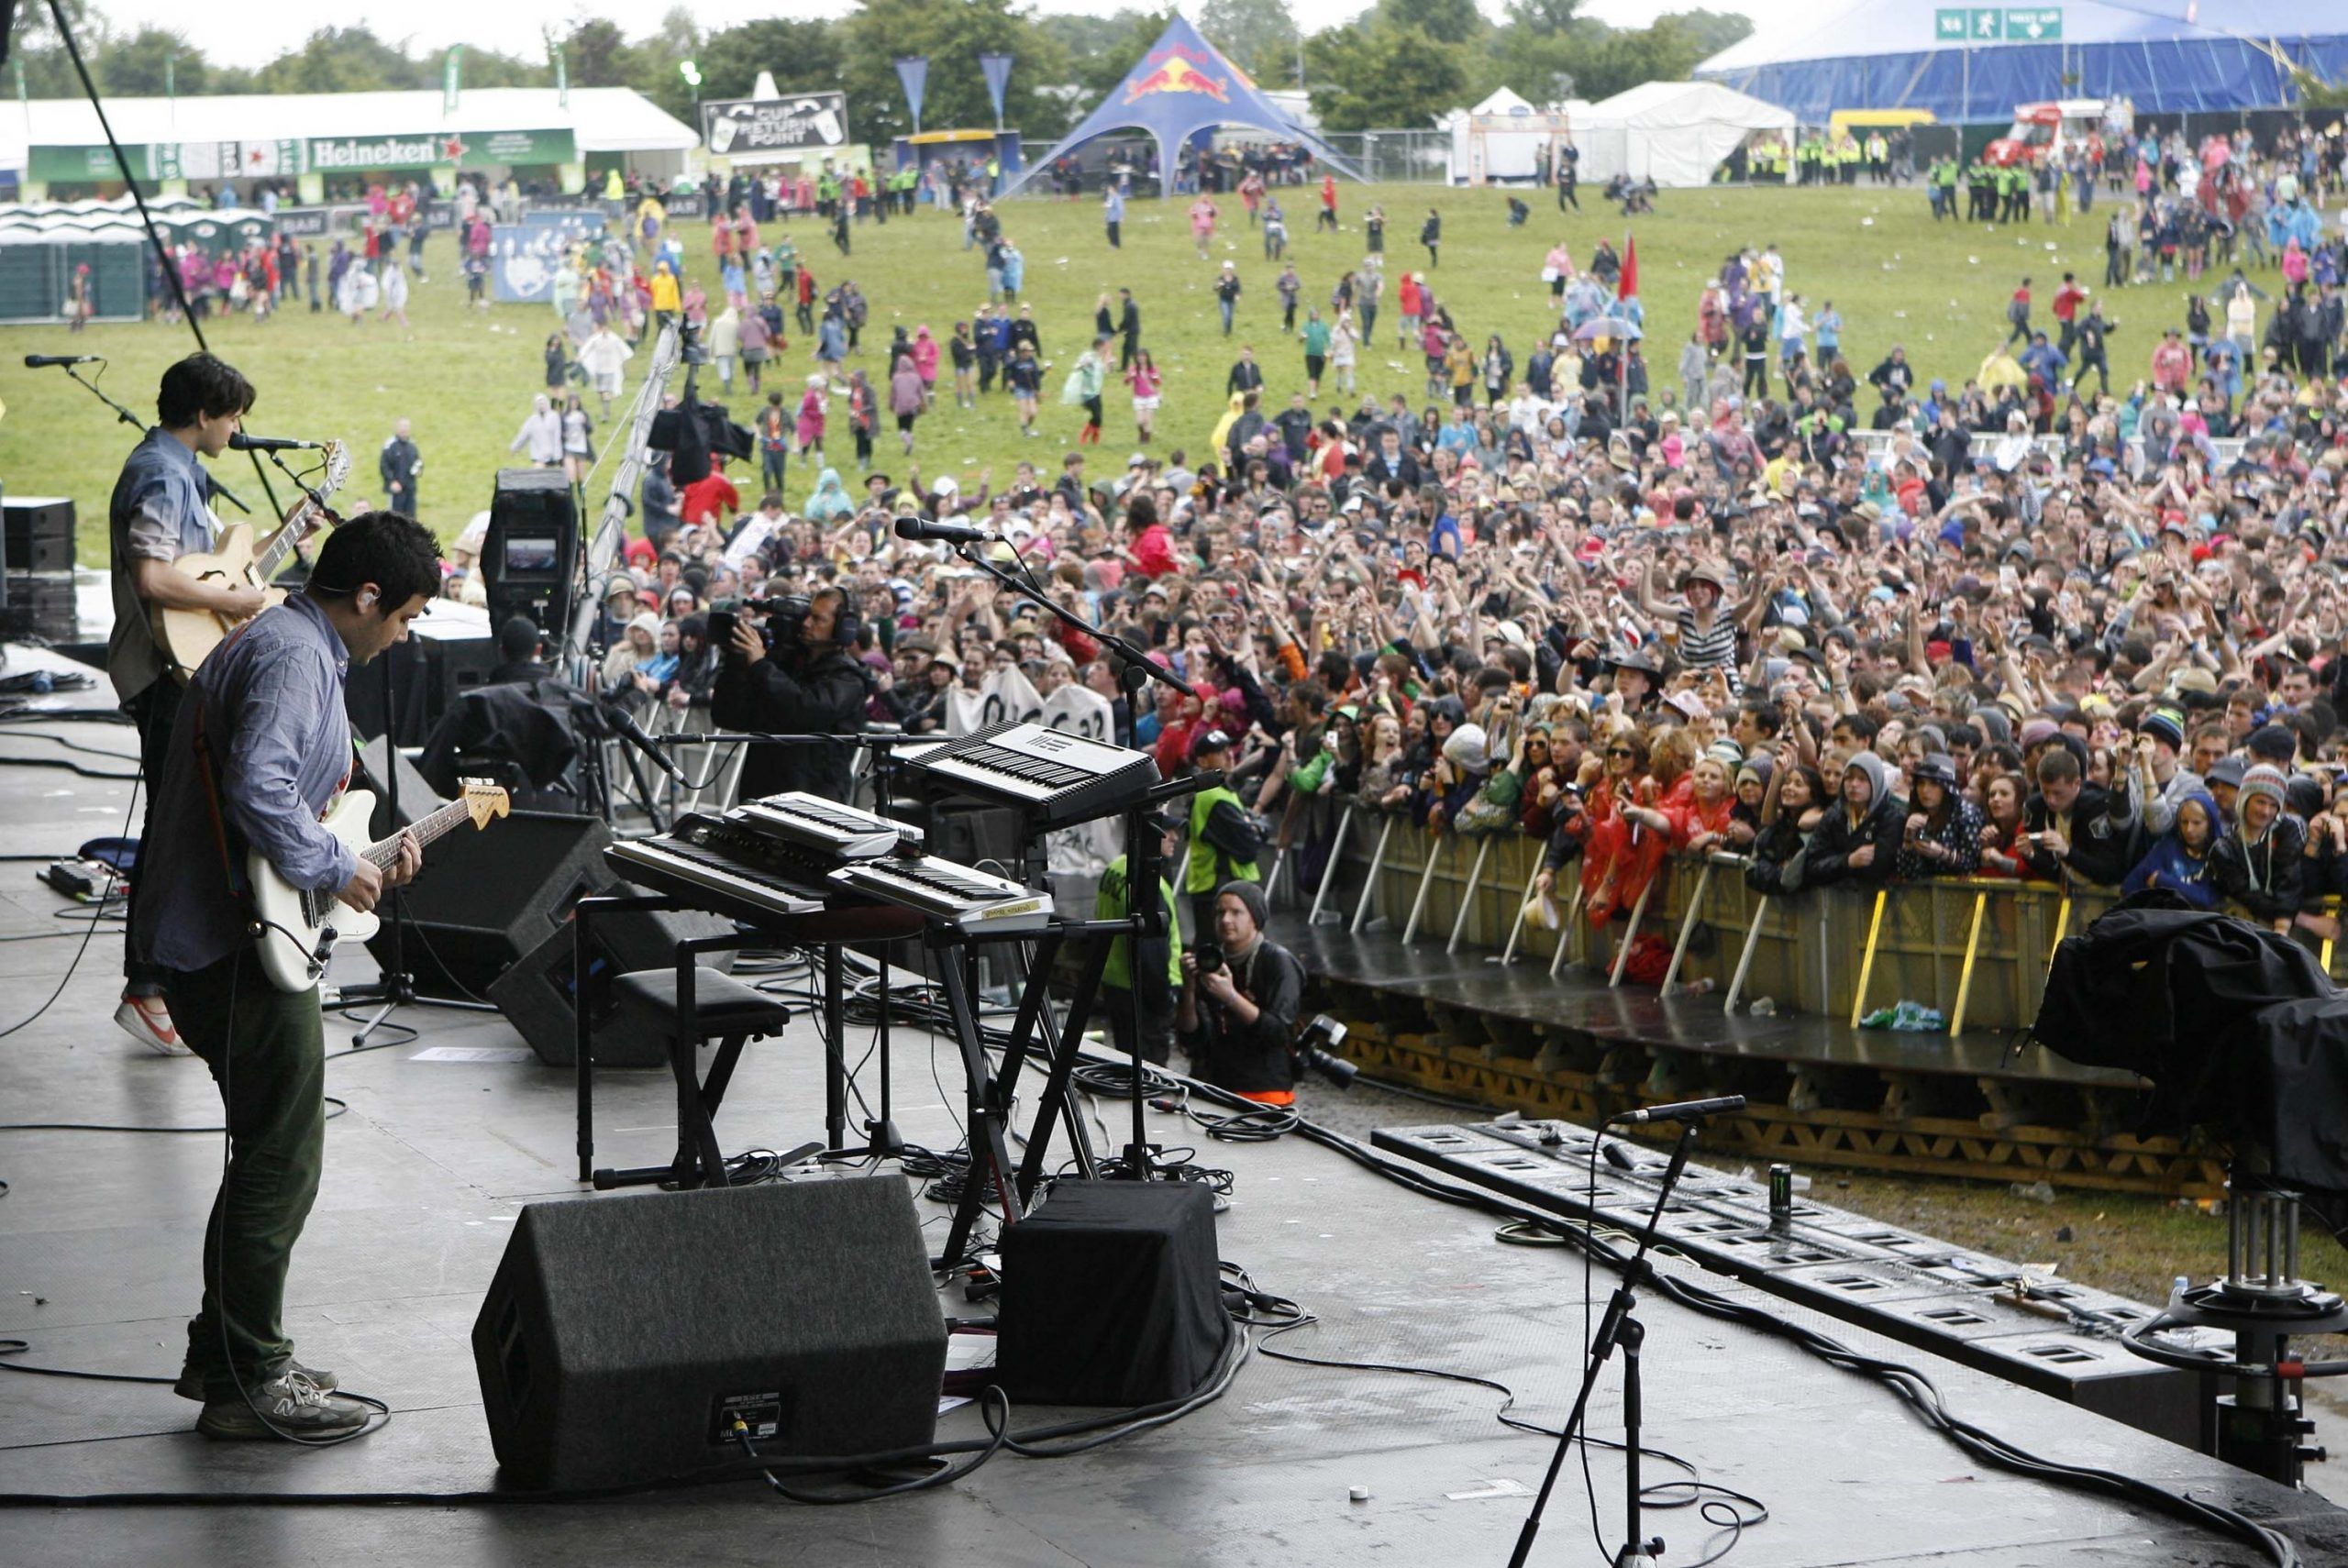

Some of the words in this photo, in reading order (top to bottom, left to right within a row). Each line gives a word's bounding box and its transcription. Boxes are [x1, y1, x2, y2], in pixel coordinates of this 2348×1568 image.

[755, 106, 795, 122] CUP
[737, 118, 815, 136] RETURN
[747, 132, 805, 147] POINT
[314, 138, 435, 167] Heineken
